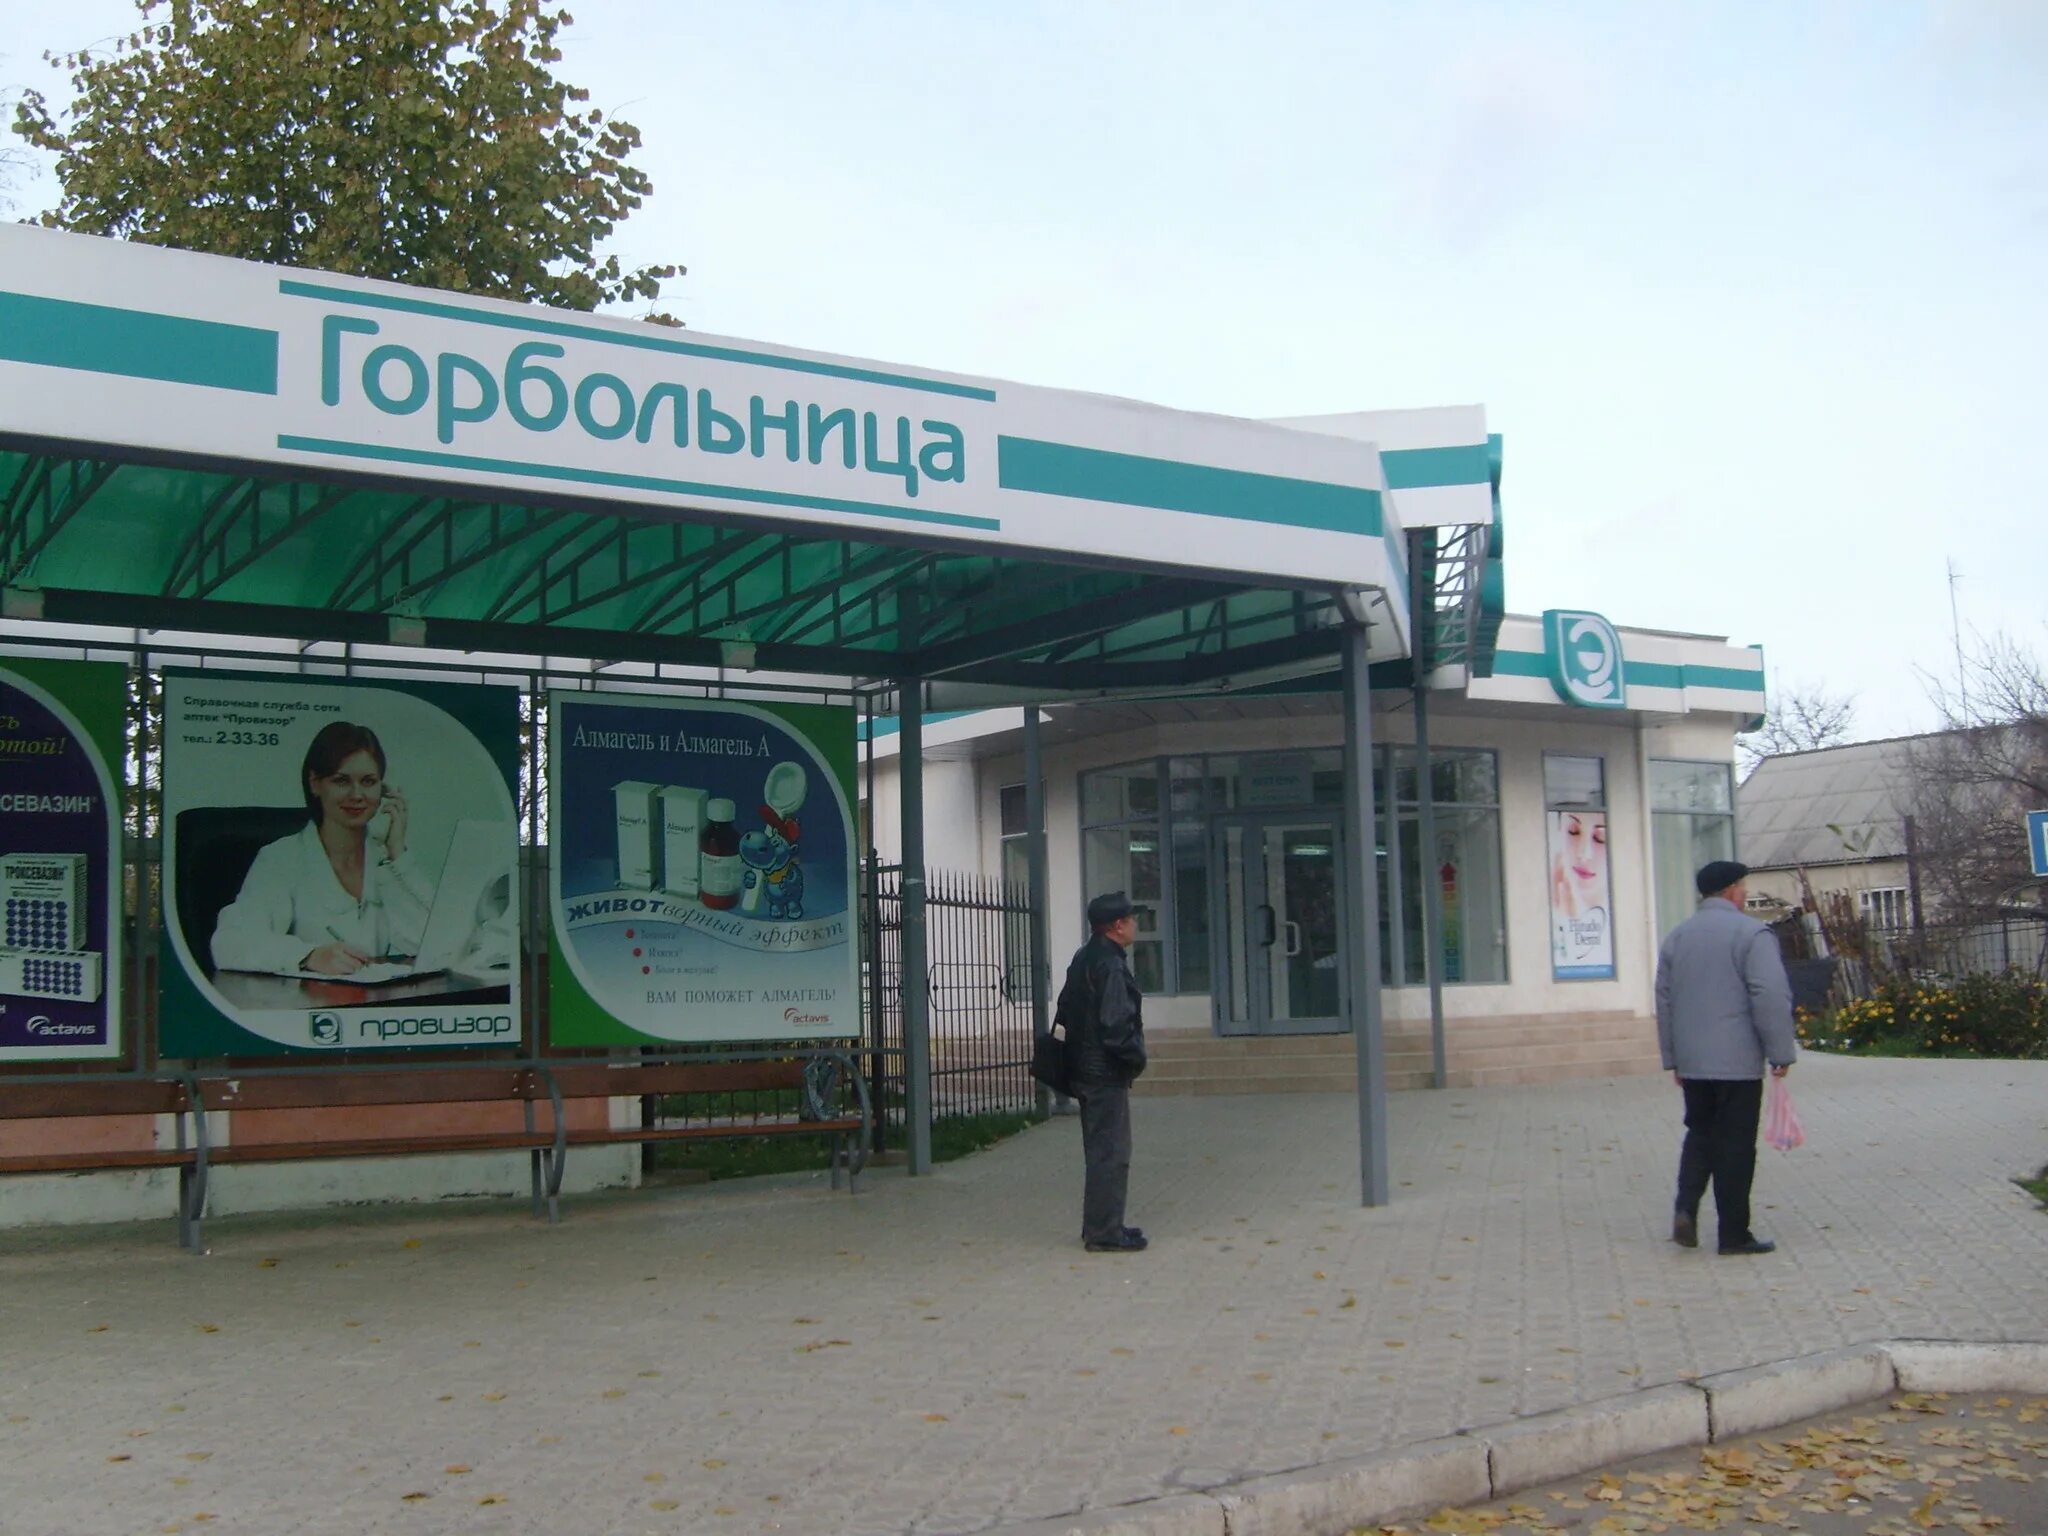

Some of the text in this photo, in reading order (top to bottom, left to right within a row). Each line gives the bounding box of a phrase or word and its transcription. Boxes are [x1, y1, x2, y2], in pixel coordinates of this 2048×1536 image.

[320, 313, 966, 498] Горбольница
[183, 696, 341, 712] Справочная служба сети
[183, 713, 219, 722] аптек
[216, 731, 280, 746] 2-33-36
[572, 723, 770, 757] Алмагель и Алмагель А
[751, 921, 845, 947] эффект
[647, 989, 837, 1004] ВАМ ПОМОЖЕТ АЛМАГЕЛЬ!
[792, 1012, 830, 1024] actavis
[39, 1021, 97, 1036] actavis
